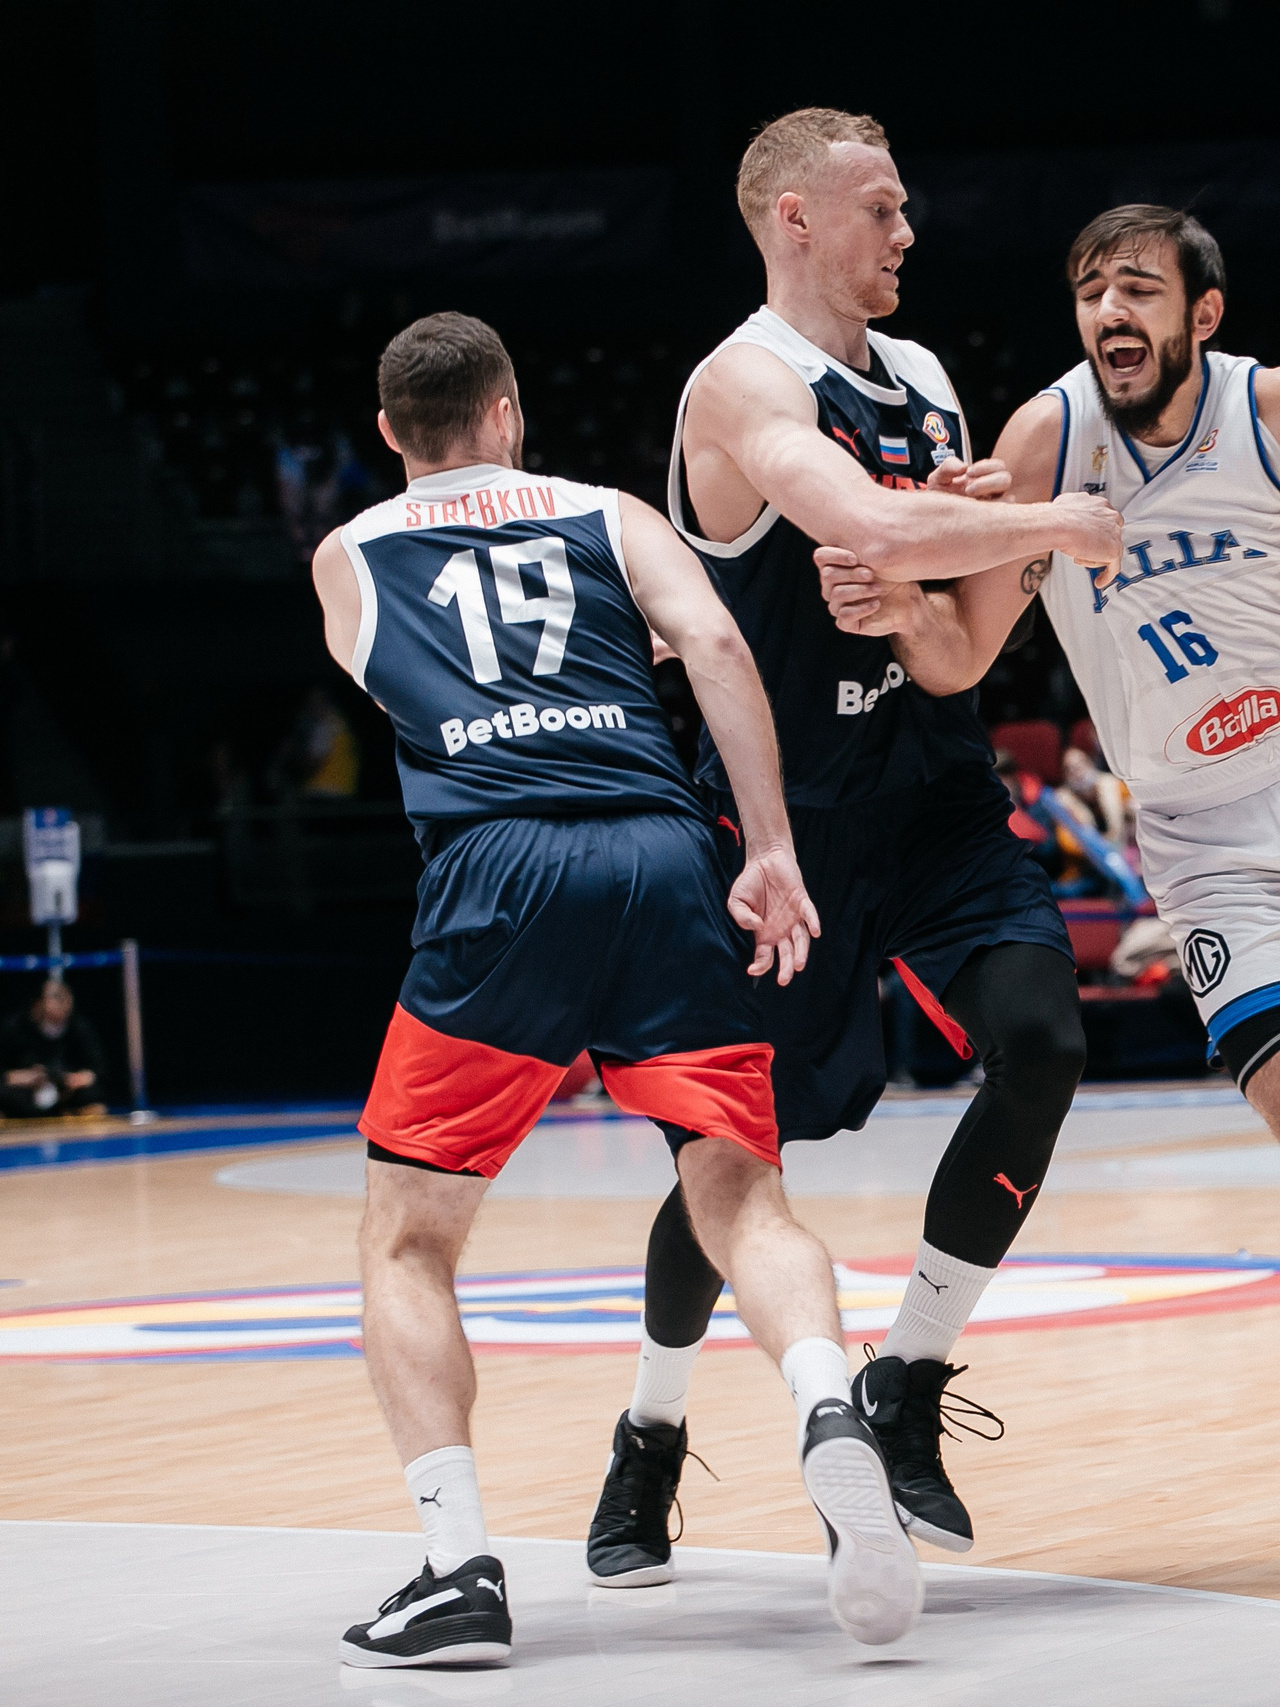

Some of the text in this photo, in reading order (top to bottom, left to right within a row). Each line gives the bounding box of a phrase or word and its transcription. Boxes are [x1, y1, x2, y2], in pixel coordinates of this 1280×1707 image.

[406, 486, 557, 530] STREBKOV
[427, 536, 577, 684] 19
[1137, 610, 1219, 684] 16
[440, 703, 627, 757] BetBoom
